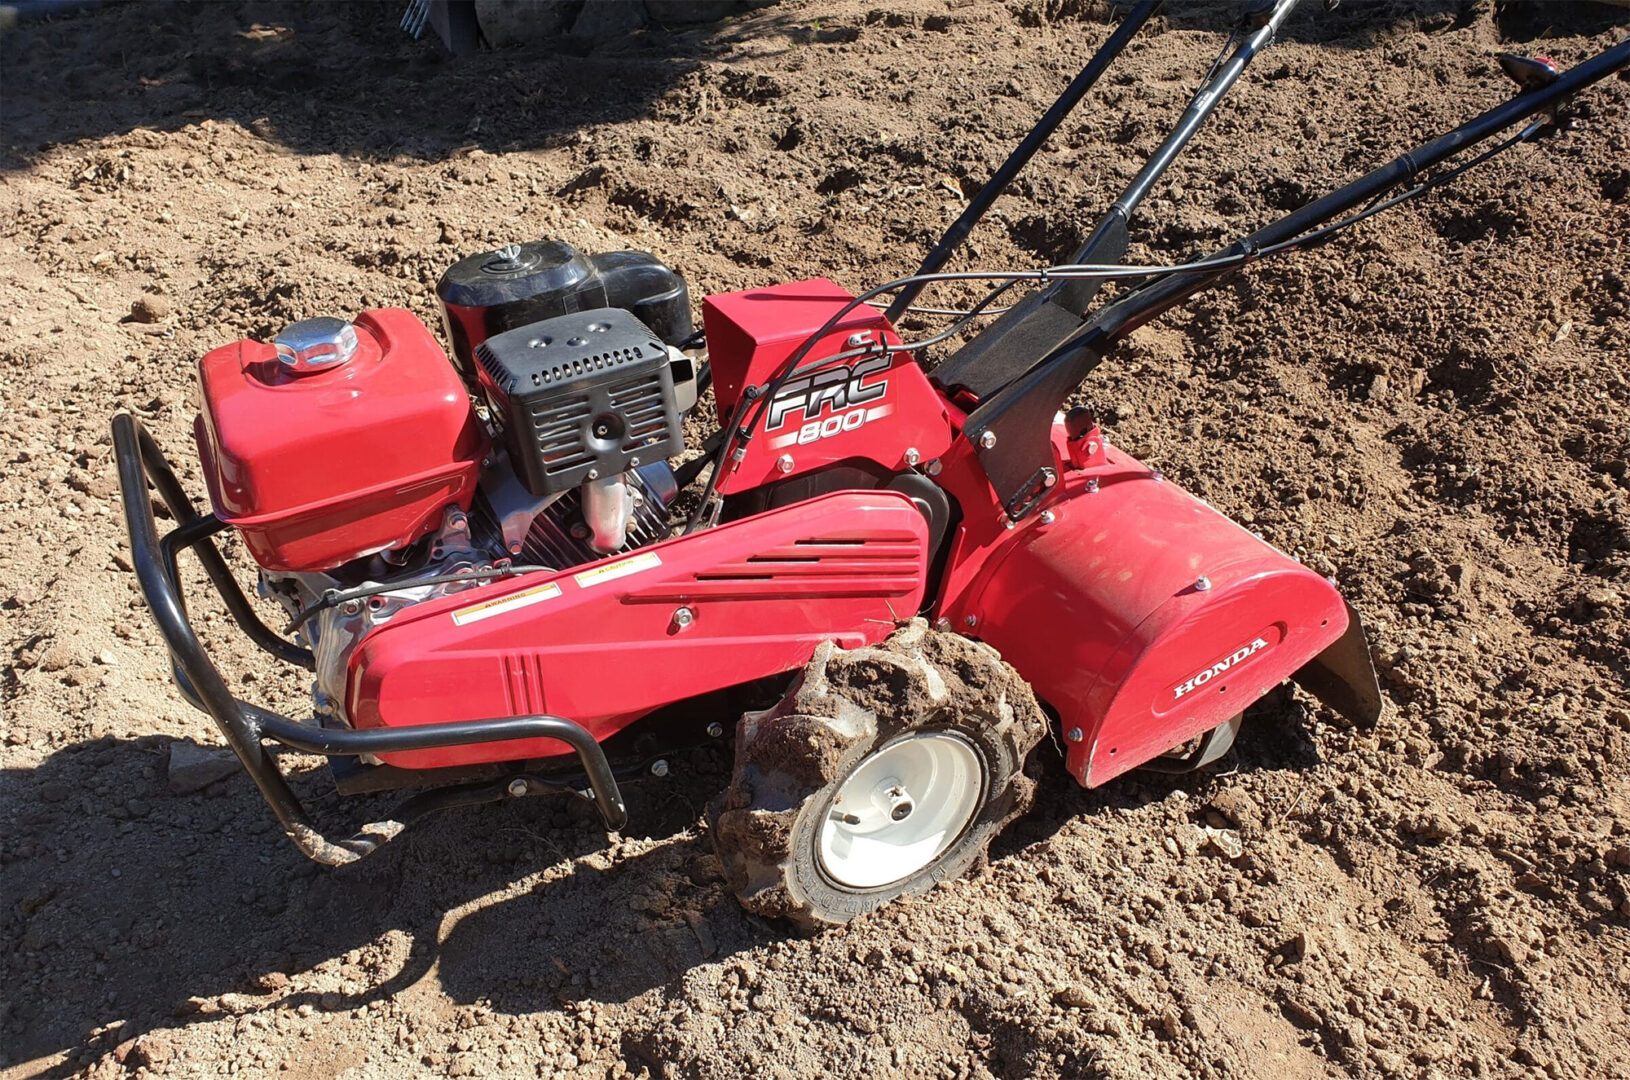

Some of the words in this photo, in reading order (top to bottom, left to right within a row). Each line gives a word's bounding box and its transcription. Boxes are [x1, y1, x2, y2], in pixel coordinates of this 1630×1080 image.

[765, 352, 894, 431] FRC
[798, 409, 865, 443] 800
[491, 592, 526, 607] WARNING
[1174, 638, 1268, 699] HONDA
